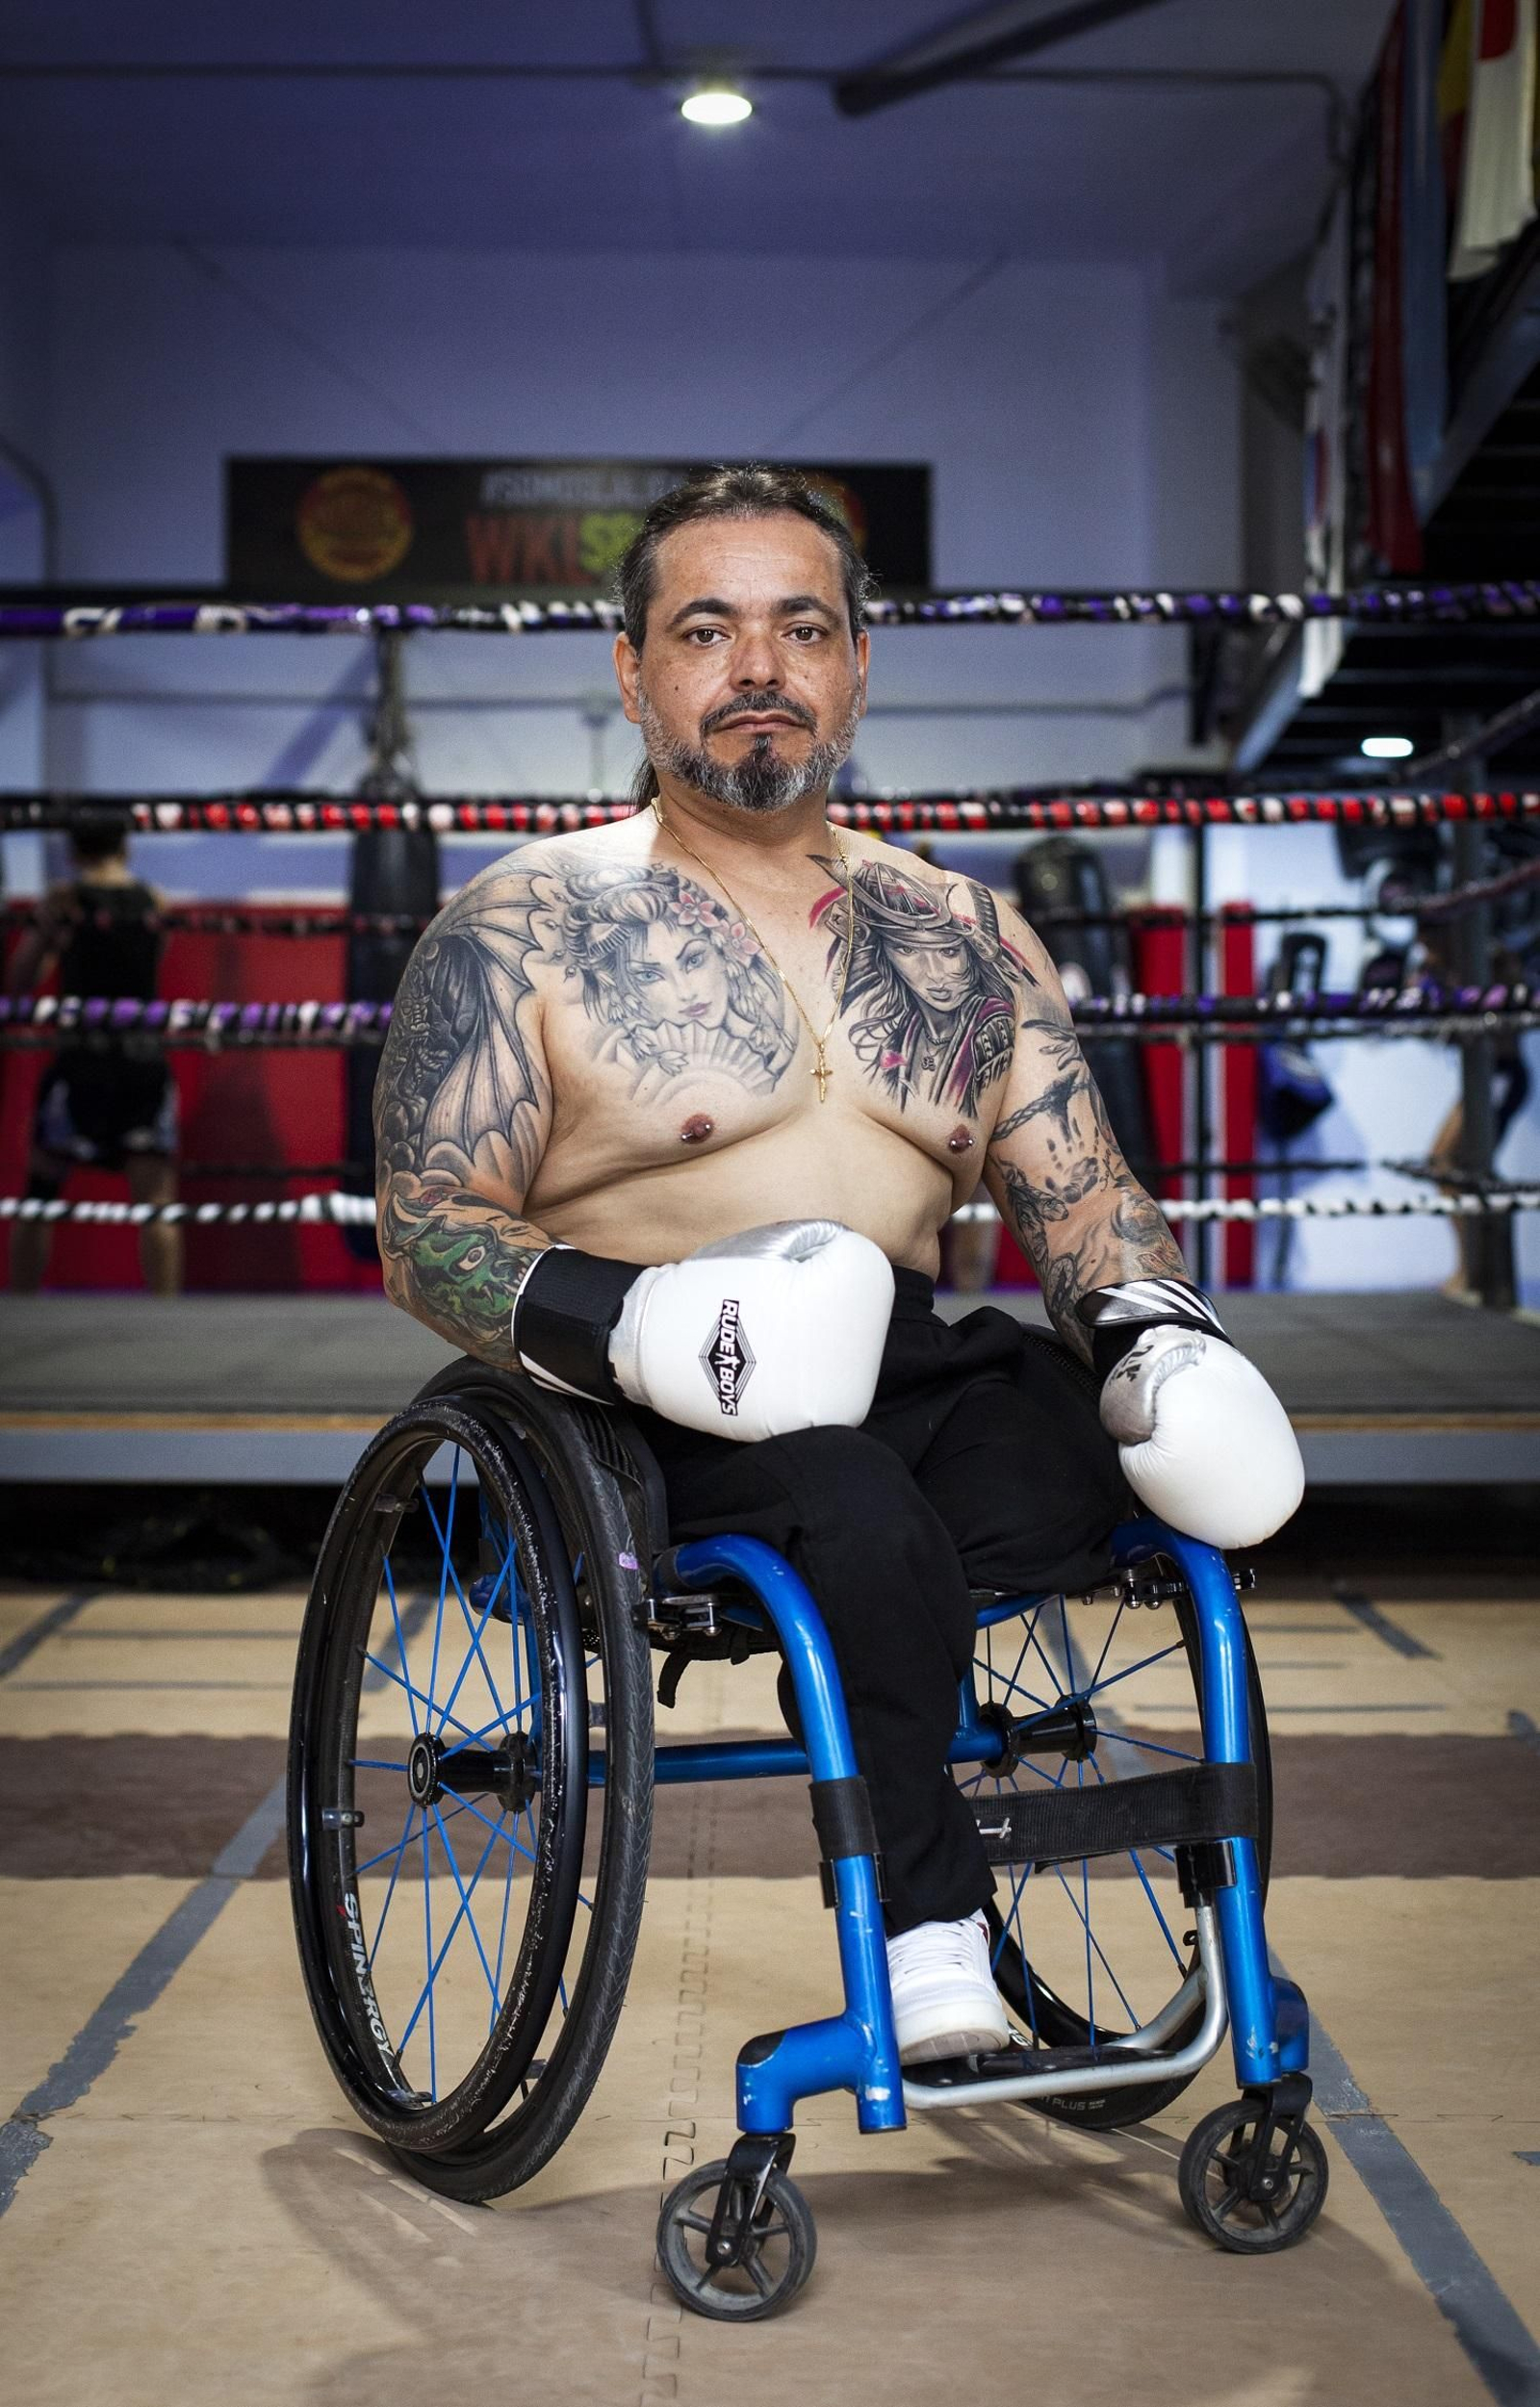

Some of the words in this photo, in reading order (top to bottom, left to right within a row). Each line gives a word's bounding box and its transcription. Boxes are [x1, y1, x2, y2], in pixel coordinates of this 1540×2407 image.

[719, 1299, 739, 1355] RUDE
[719, 1367, 738, 1416] BOYS
[344, 1892, 395, 2061] SPINERGY
[1052, 2097, 1087, 2112] PLUS
